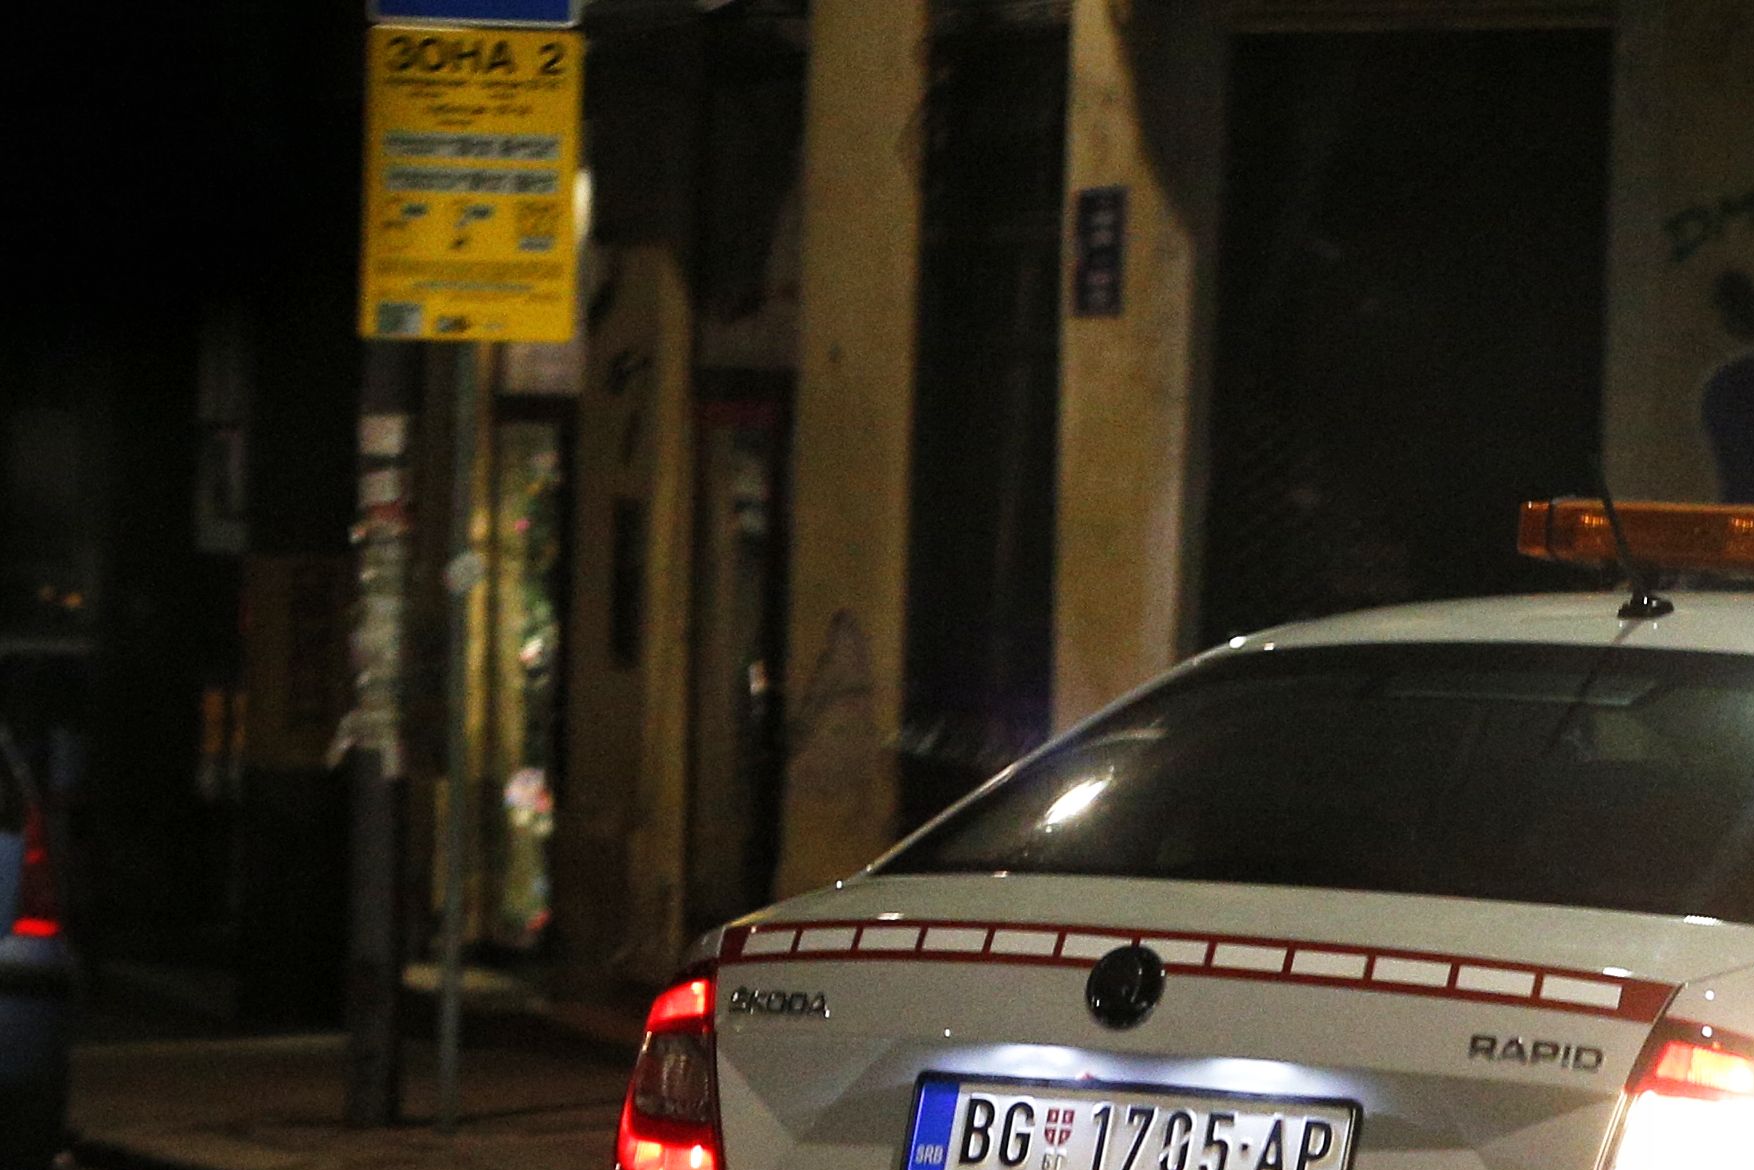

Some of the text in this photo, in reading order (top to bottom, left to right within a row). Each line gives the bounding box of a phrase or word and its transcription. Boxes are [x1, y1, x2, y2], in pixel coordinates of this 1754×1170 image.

[382, 35, 567, 77] ЗОНА 2
[1469, 1033, 1604, 1073] RAPID
[958, 1097, 1036, 1167] BG
[914, 1144, 944, 1165] SRB
